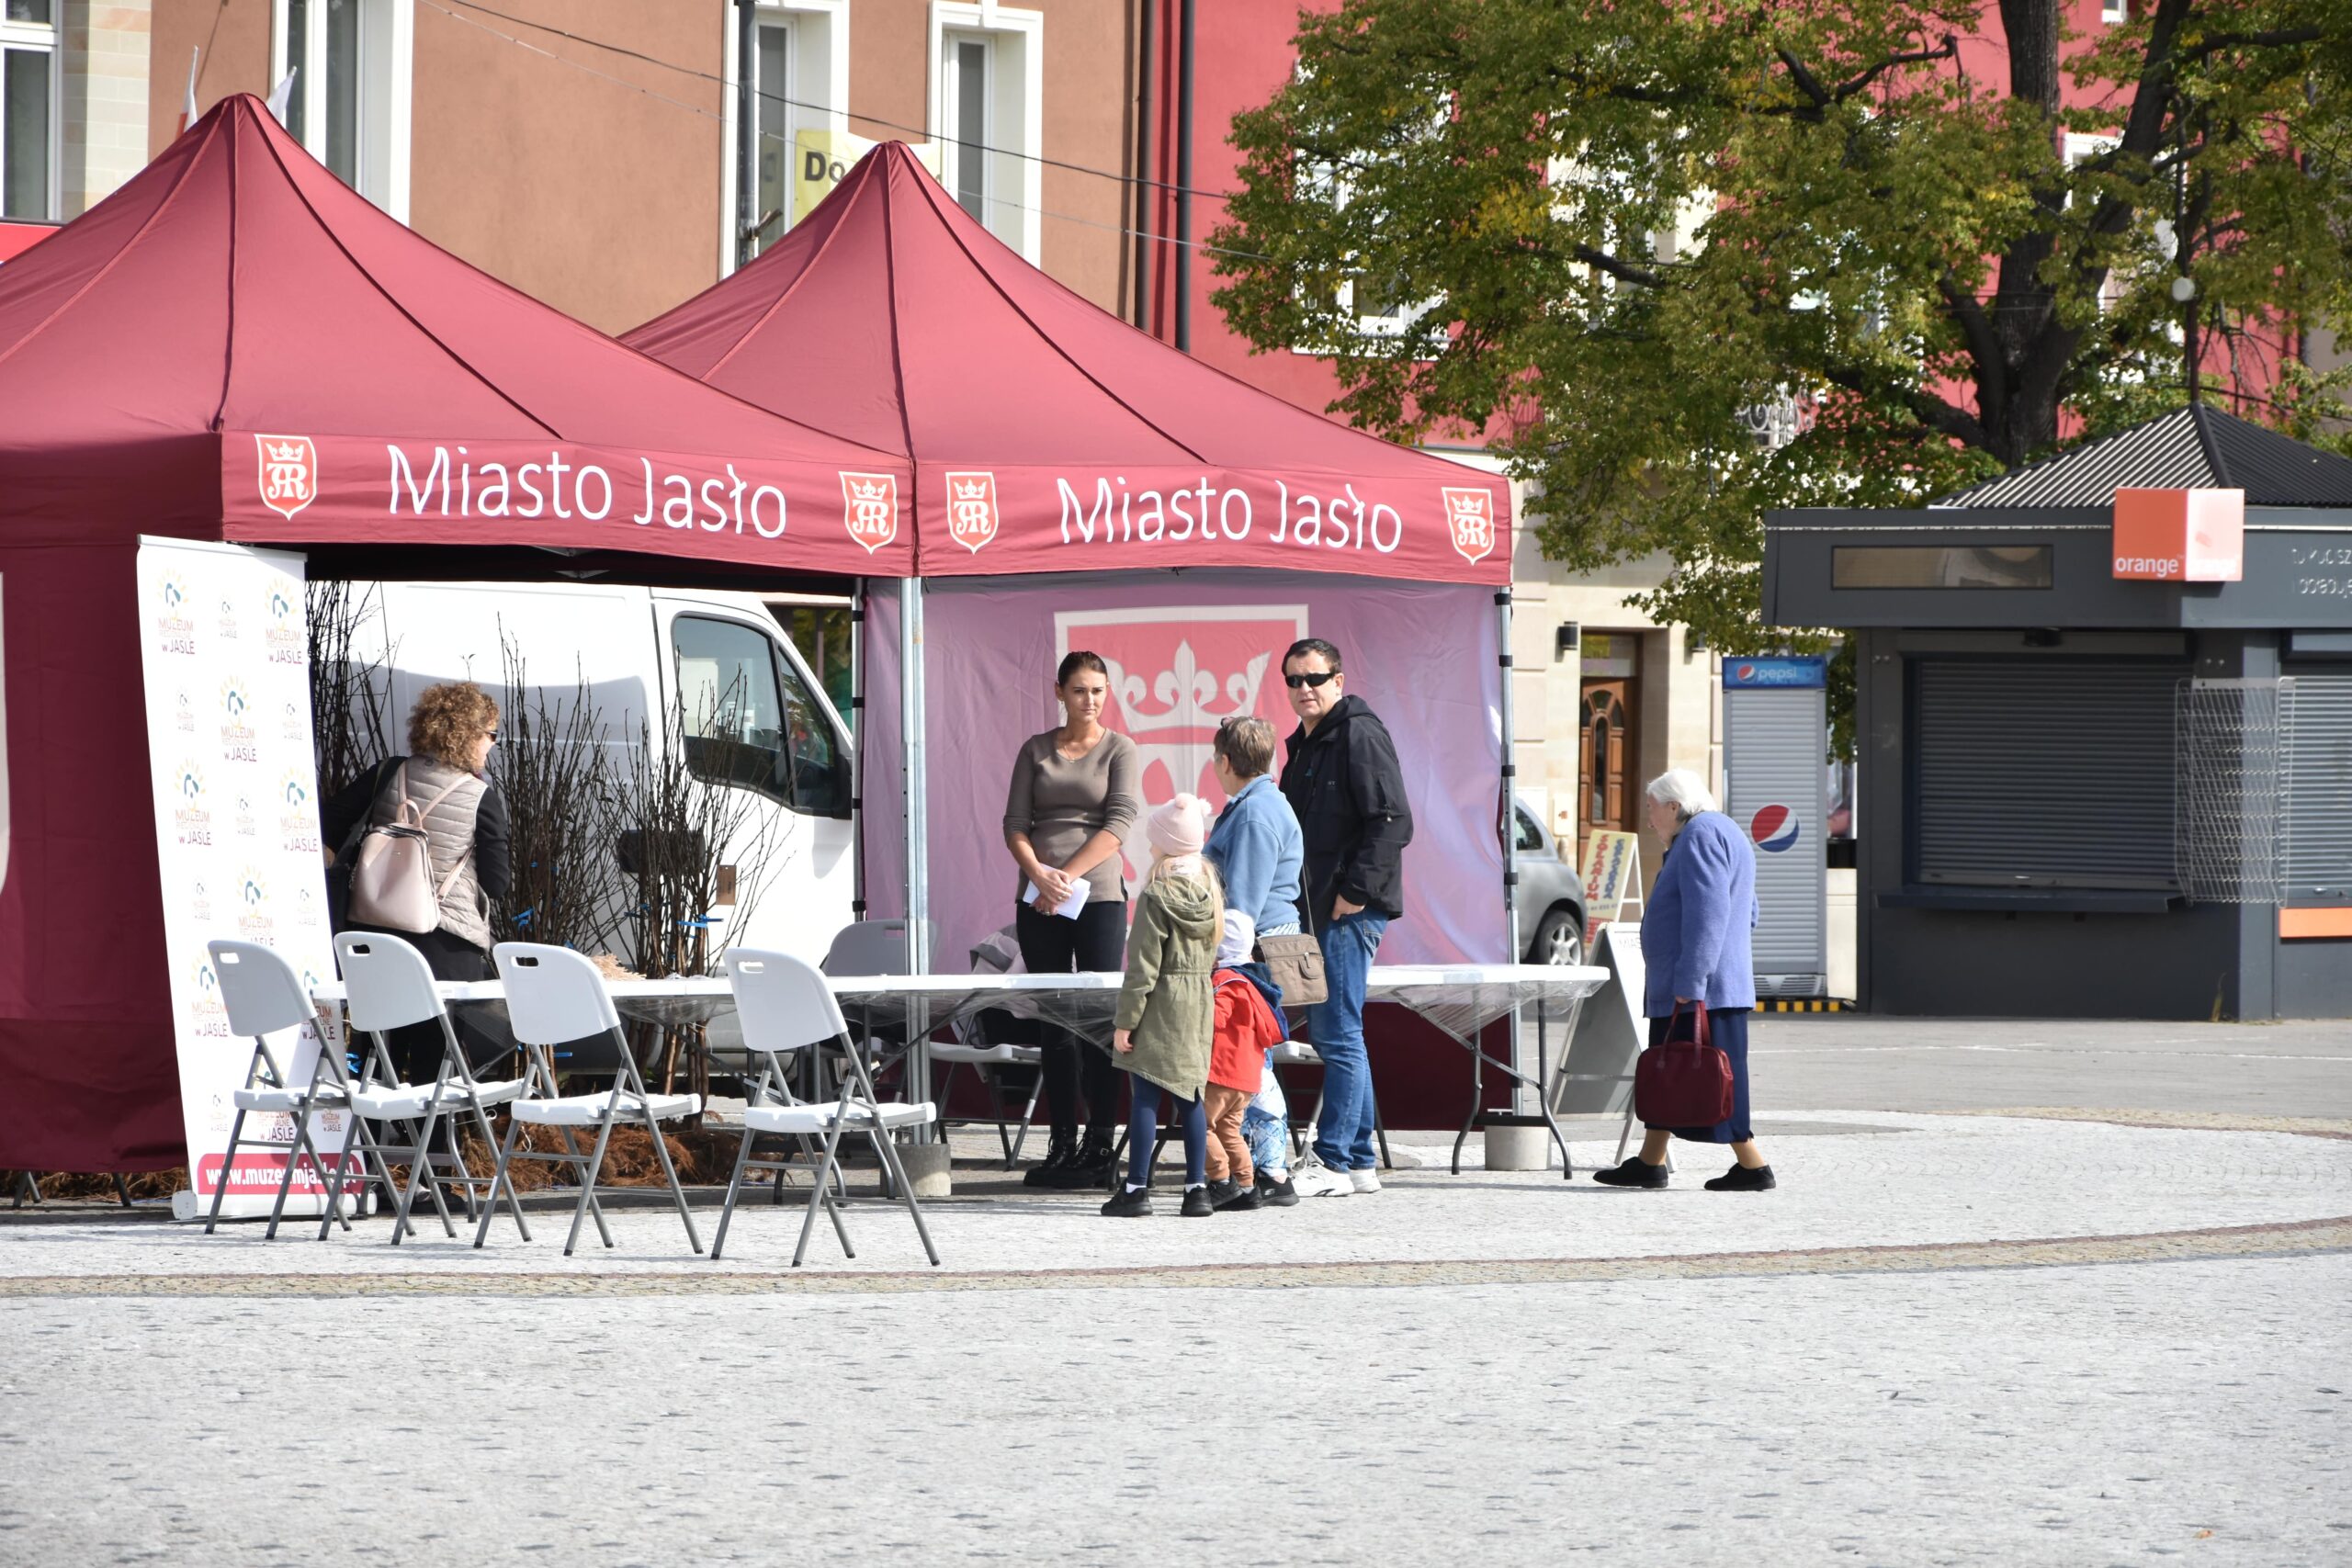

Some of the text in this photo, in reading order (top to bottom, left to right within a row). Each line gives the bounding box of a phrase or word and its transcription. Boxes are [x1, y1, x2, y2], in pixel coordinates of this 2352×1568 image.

[387, 445, 786, 538] Miasto Jasło
[1057, 476, 1403, 553] Miasto Jasło
[2114, 558, 2179, 579] orange
[1758, 667, 1797, 682] pepsi
